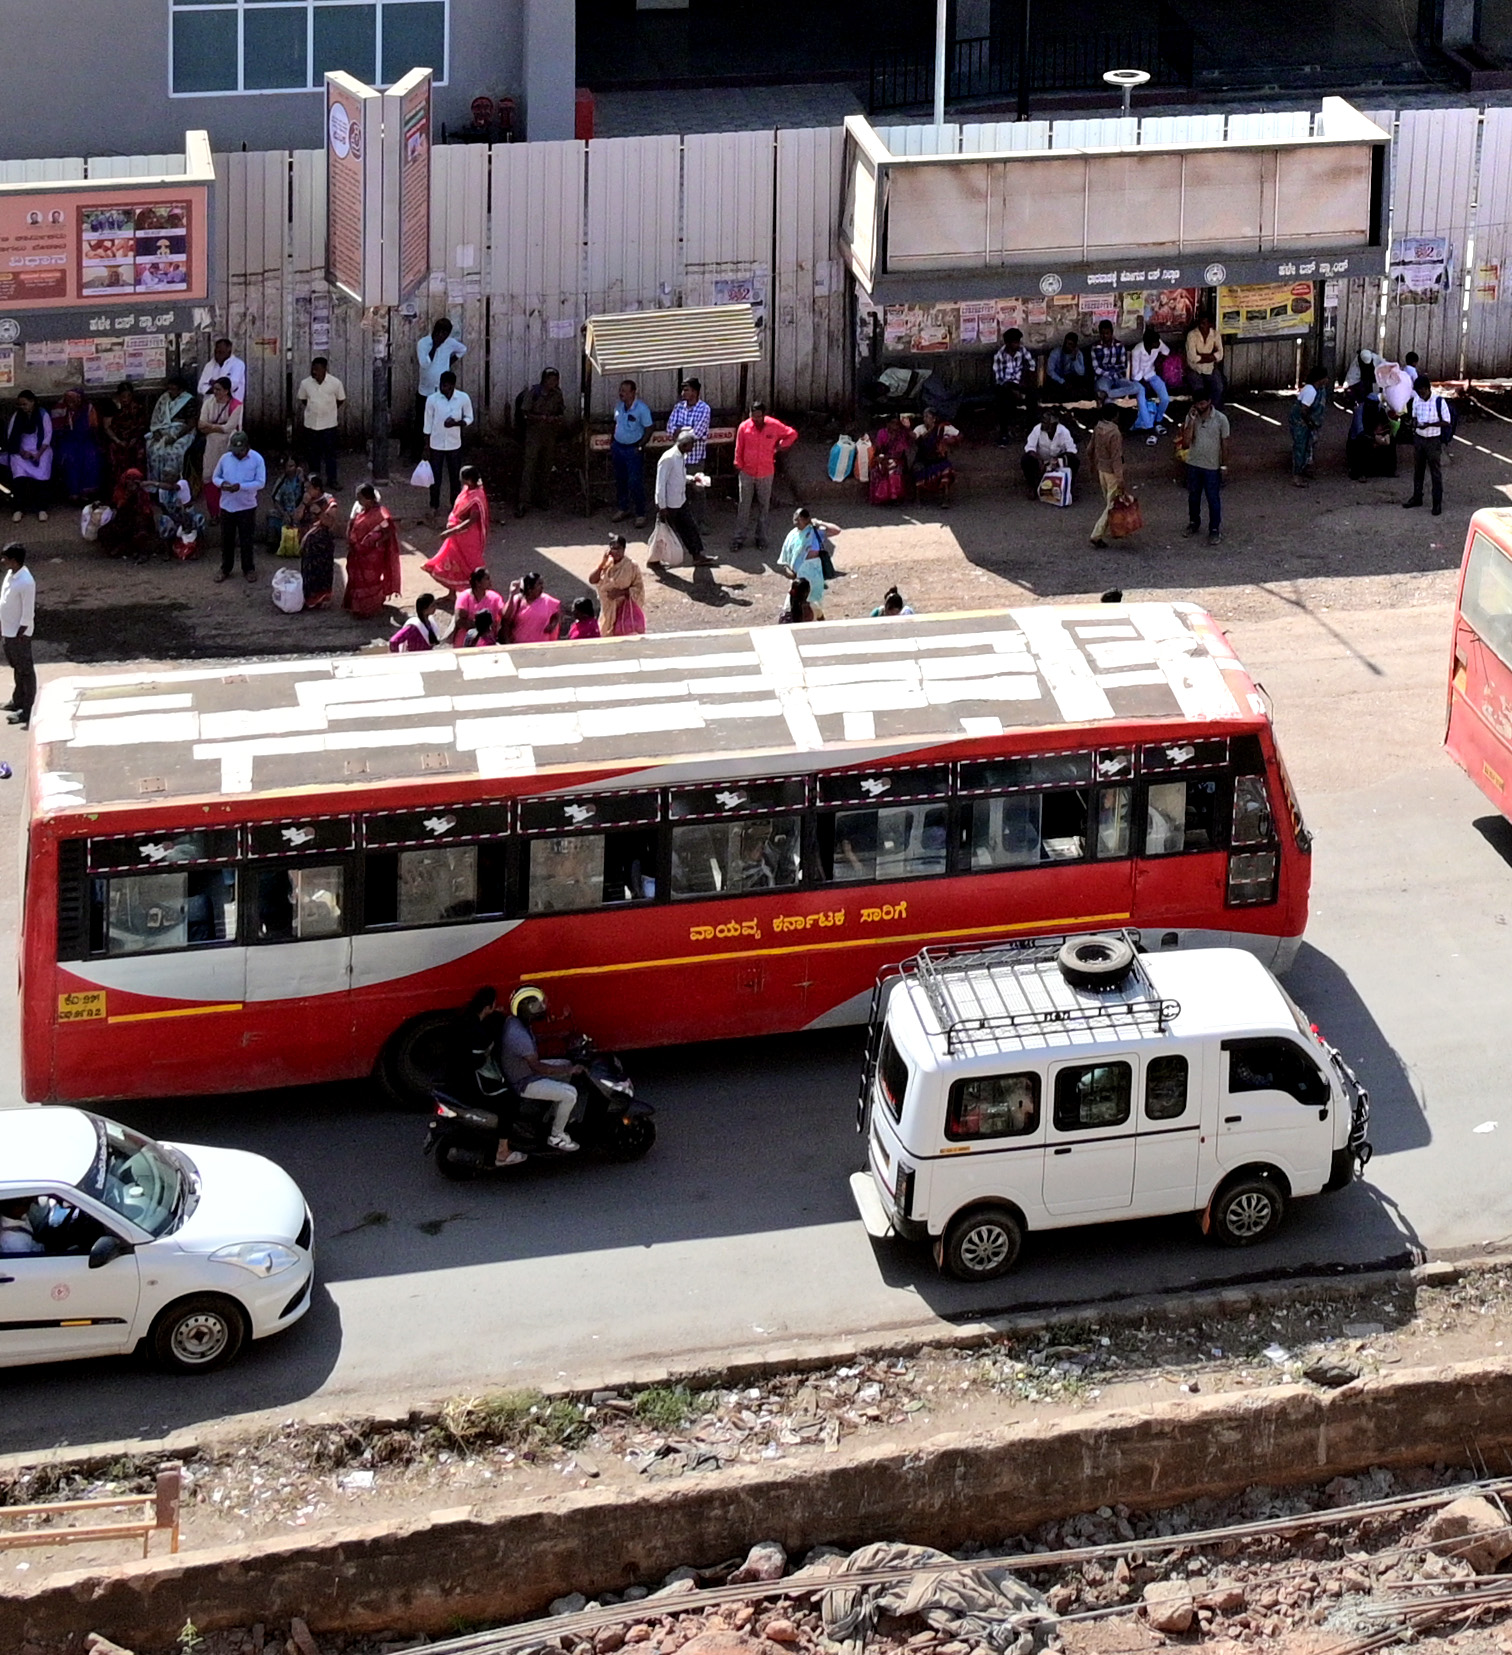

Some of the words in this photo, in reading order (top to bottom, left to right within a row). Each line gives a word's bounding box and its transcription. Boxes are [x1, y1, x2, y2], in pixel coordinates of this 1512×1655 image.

[689, 917, 762, 941] ವಾಯವ್ಯ
[772, 907, 846, 932] ಕರ್ನಾಟಕ
[859, 900, 909, 924] ಸಾರಿಗೆ
